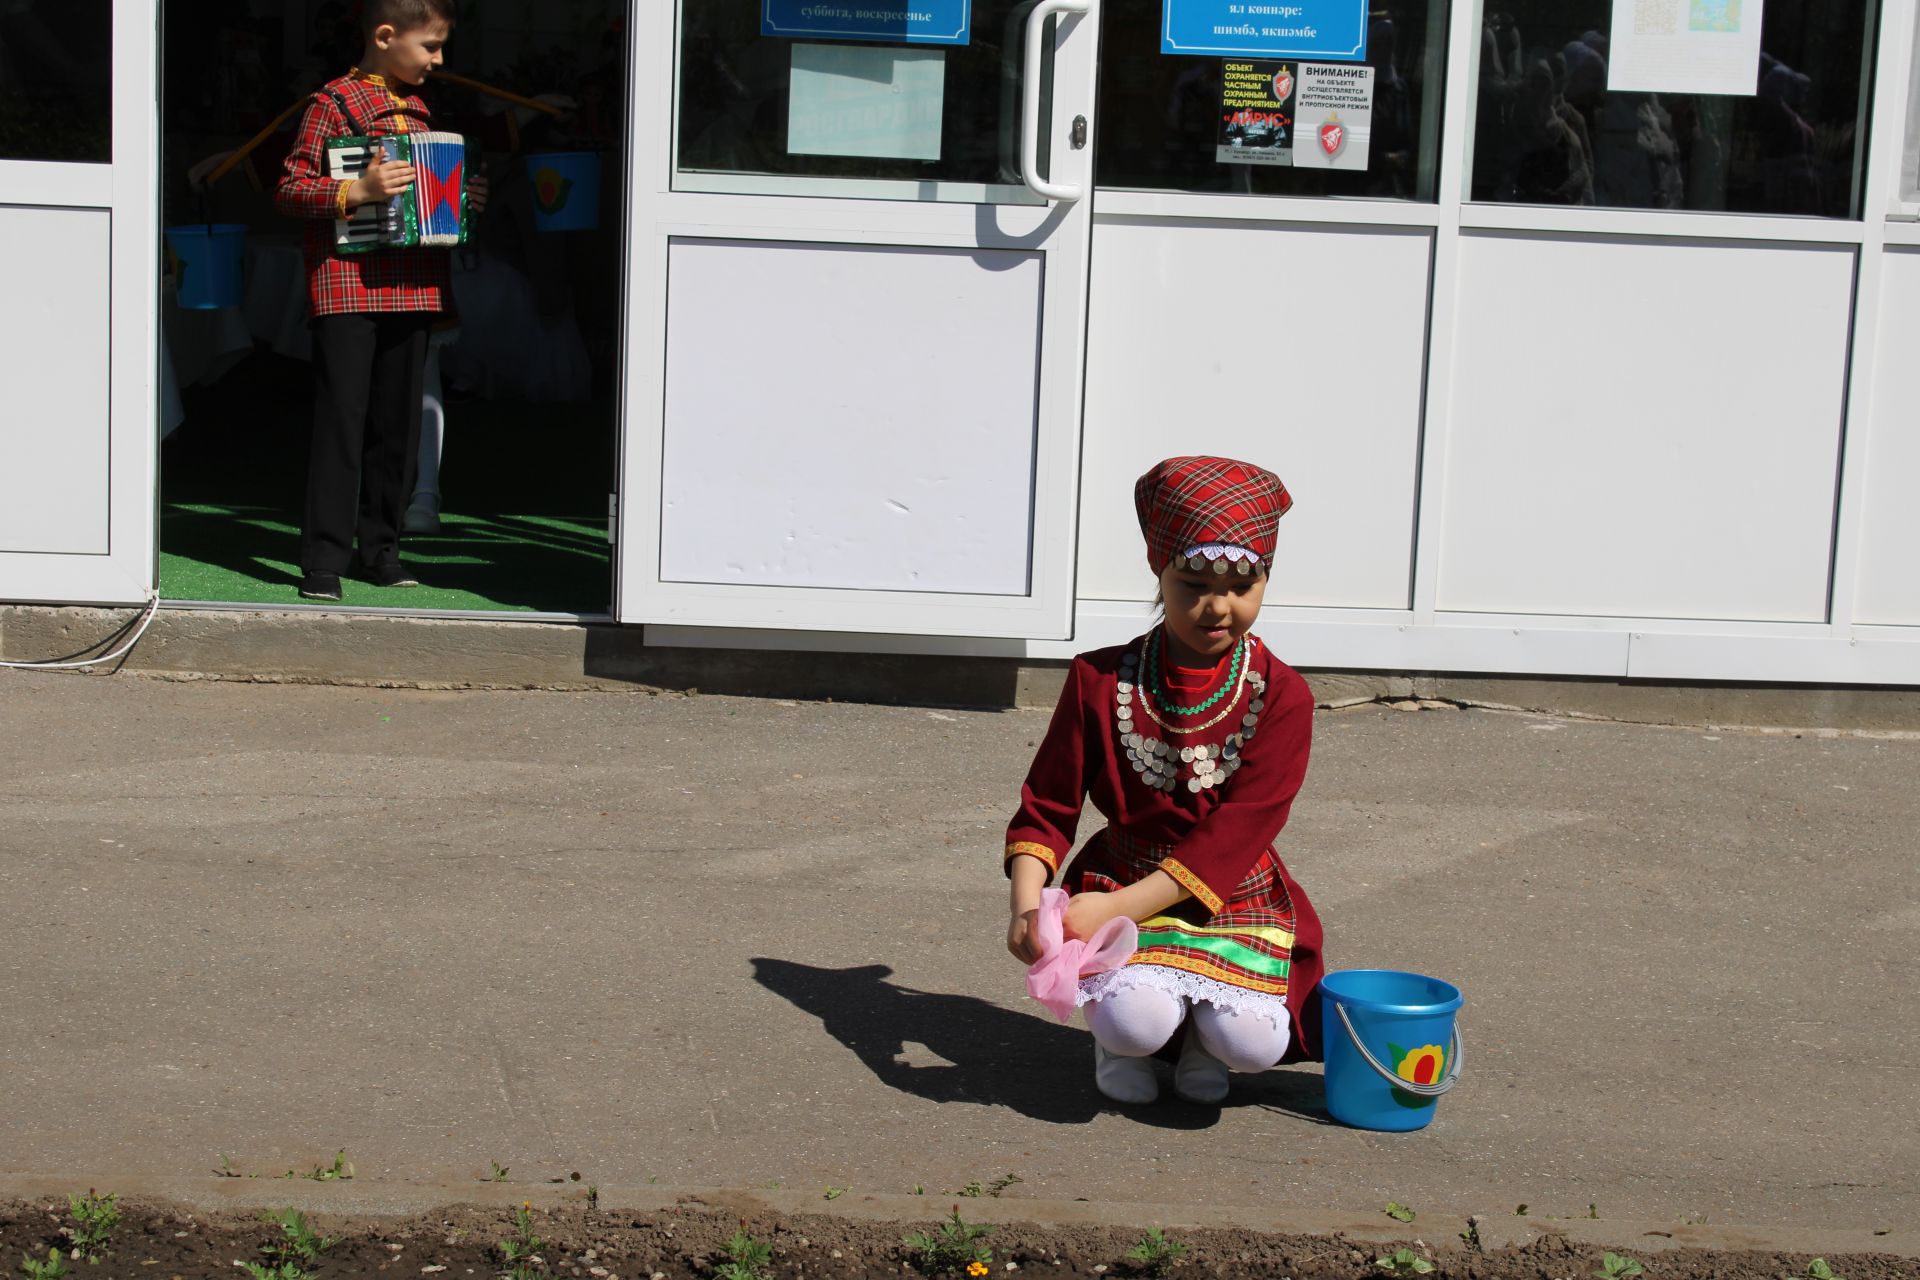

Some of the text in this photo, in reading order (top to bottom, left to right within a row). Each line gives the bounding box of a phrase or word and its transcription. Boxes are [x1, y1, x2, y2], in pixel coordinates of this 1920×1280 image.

[801, 5, 933, 23] суббота, воскресенье
[1229, 4, 1302, 18] ял көннәре:
[1213, 24, 1317, 38] шимбә, якшәмбе
[1225, 63, 1253, 72] ОБЪЕКТ
[1306, 66, 1368, 79] ВНИМАНИЕ!
[1224, 72, 1272, 82] ОХРАНЯЕТСЯ
[1224, 81, 1262, 90] ЧАСТНЫМ
[1326, 79, 1355, 87] ОБЪЕКТЕ
[1223, 90, 1267, 99] ОХРАННЫМ
[1306, 86, 1364, 95] ОСУЩЕСТВЛЯЕТСЯ
[1301, 93, 1368, 103] ВНУТРИОБЪЕКТОВЫЙ
[1223, 98, 1281, 109] ПРЕДПРИЯТИЕМ
[1305, 101, 1346, 110] ПРОПУСКНОЙ
[1347, 103, 1370, 111] РЕЖИМ
